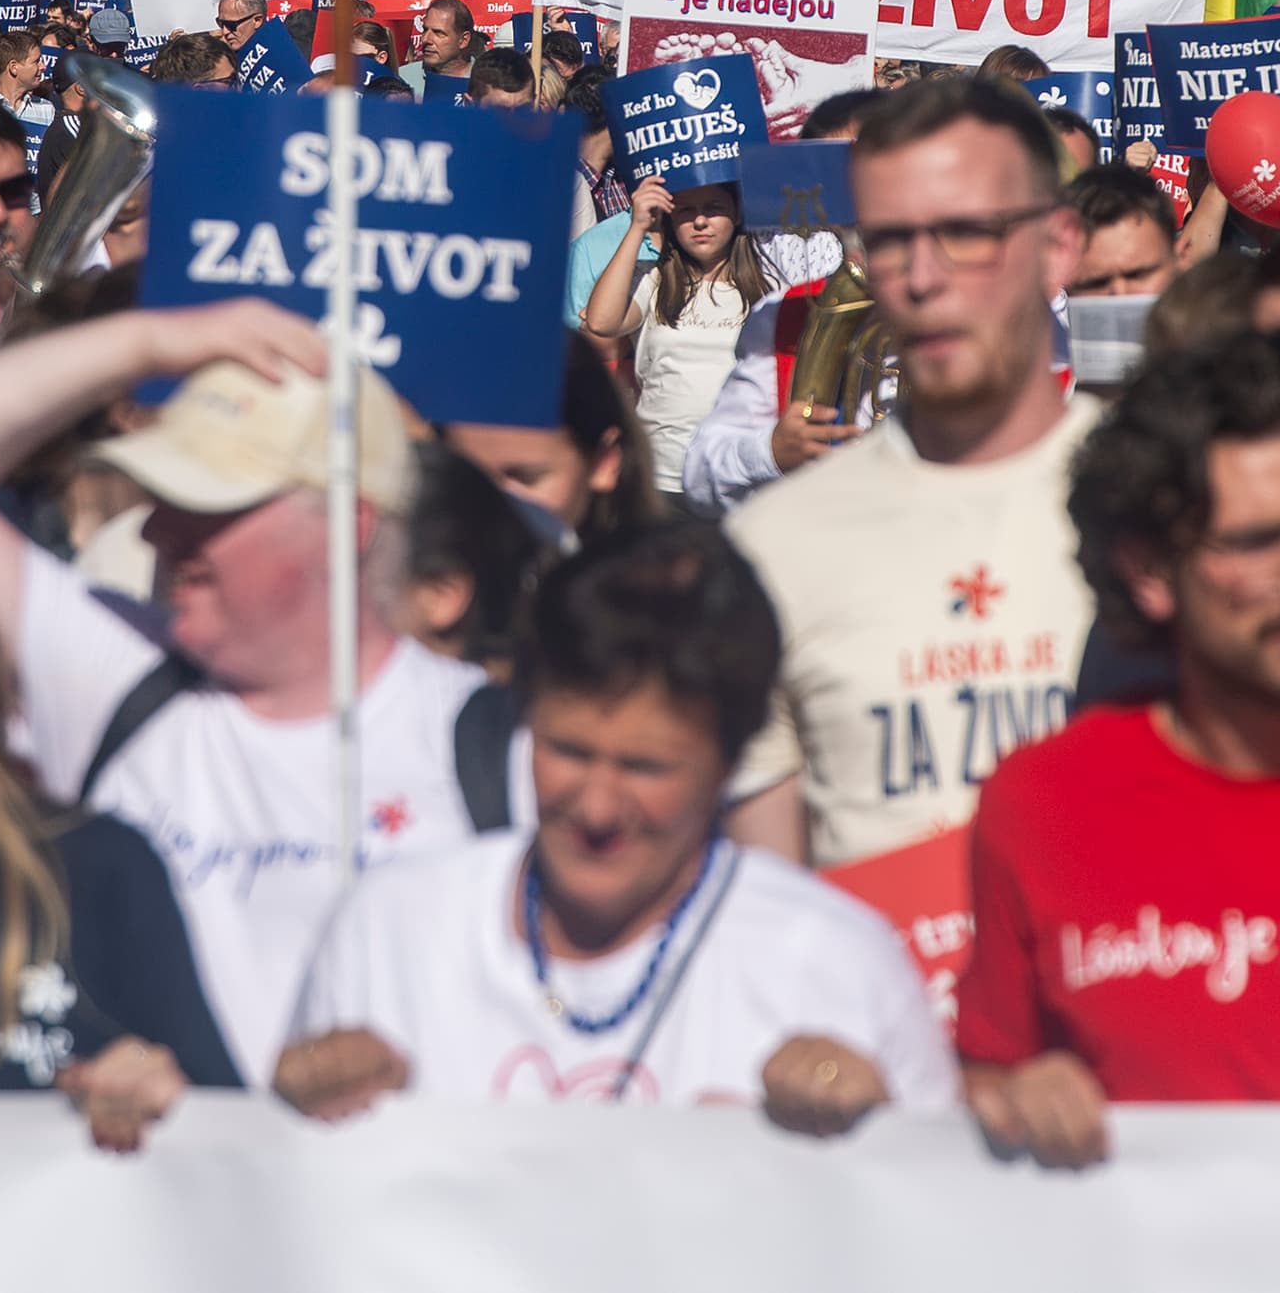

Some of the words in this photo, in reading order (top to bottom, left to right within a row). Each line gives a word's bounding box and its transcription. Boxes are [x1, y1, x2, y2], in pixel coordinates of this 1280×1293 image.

[24, 4, 37, 22] JE
[488, 2, 513, 12] Dieťa
[623, 94, 651, 118] Keď
[654, 92, 676, 111] ho
[625, 103, 745, 155] MILUJEŠ,
[280, 131, 453, 205] SOM
[633, 161, 653, 179] nie
[654, 156, 670, 177] je
[672, 151, 691, 169] čo
[693, 142, 740, 165] riešiť
[187, 218, 294, 287] ZA
[302, 208, 531, 302] ŽIVOT
[1019, 632, 1059, 670] JE
[870, 702, 940, 797] ZA
